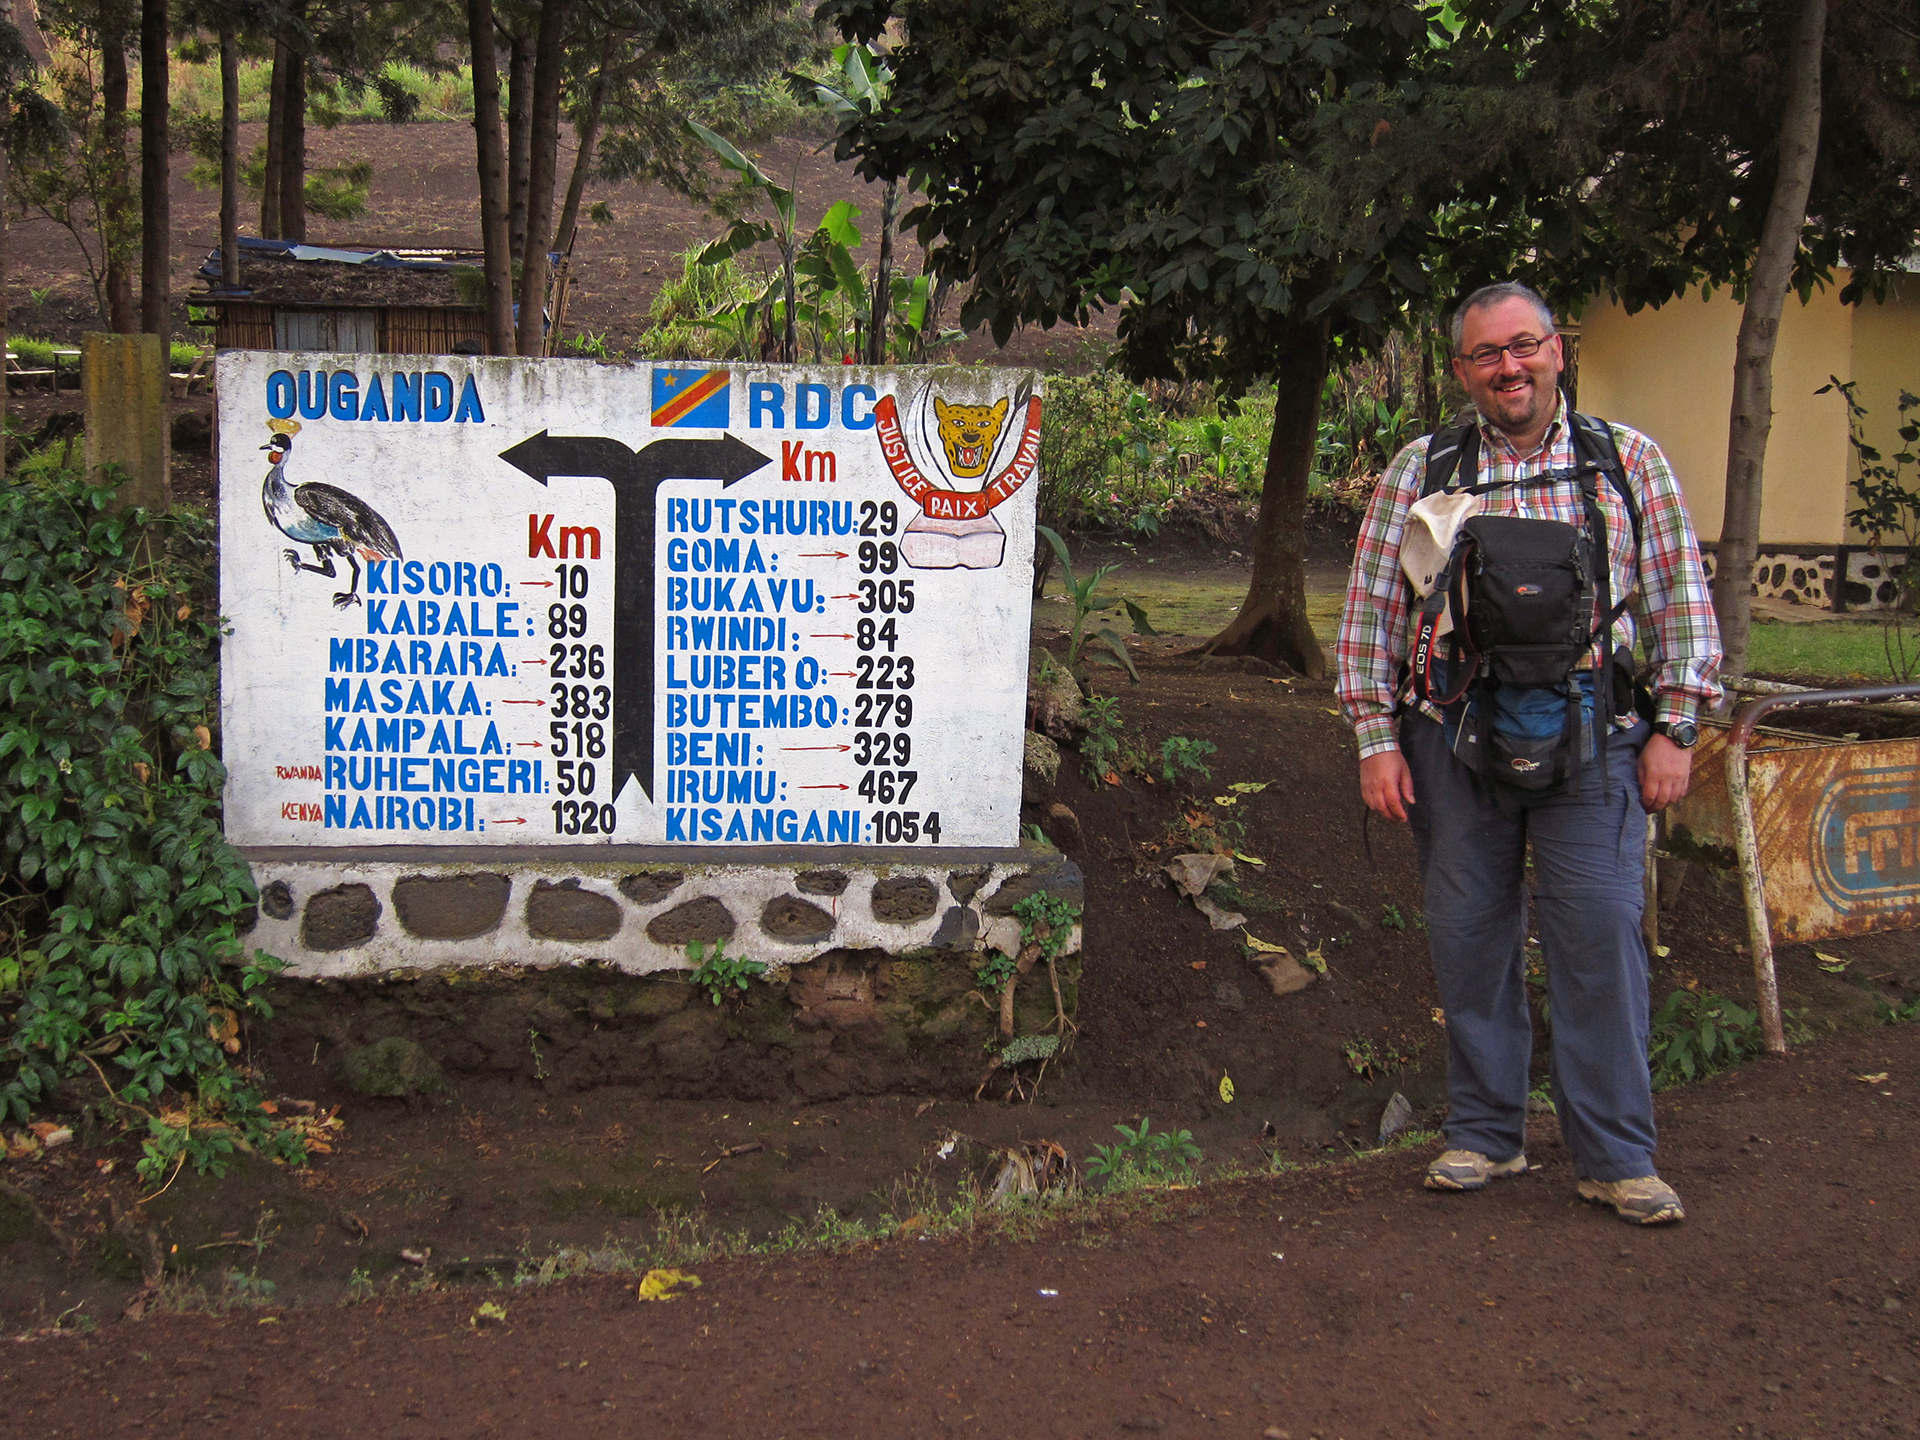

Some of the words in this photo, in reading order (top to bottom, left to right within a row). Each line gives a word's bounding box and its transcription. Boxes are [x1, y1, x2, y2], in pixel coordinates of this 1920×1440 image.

[267, 372, 485, 423] OUGANDA
[750, 383, 876, 430] RDC
[782, 441, 836, 482] Km
[877, 416, 928, 498] JUSTICE
[992, 427, 1042, 498] TRAVAIL
[668, 498, 858, 535] RUTSHURU:
[860, 501, 897, 537] 29
[930, 495, 978, 518] PAIX
[530, 514, 600, 559] Km
[668, 538, 778, 573] GOMA:
[856, 541, 899, 576] 99
[368, 561, 510, 597] KISORO:
[557, 564, 588, 598] 10
[668, 577, 825, 613] BUKAVU:
[857, 579, 916, 614] 305
[368, 600, 534, 637] KABALE:
[549, 603, 586, 639] 89
[668, 616, 799, 651] RWINDI:
[857, 617, 899, 654] 84
[1421, 625, 1432, 640] 7D
[330, 636, 518, 676] MBARARA:
[550, 643, 604, 679] 236
[855, 655, 916, 690] 223
[1416, 643, 1427, 674] EOS
[325, 678, 491, 715] MASAKA:
[551, 683, 609, 720] 383
[667, 694, 848, 728] BUTEMBO:
[855, 694, 912, 727] 279
[326, 717, 510, 754] KAMPALA:
[551, 722, 605, 758] 518
[668, 733, 763, 766] BENI:
[854, 732, 910, 766] 329
[277, 766, 322, 779] RWANDA
[325, 756, 549, 793] RUHENGERI:
[557, 761, 595, 796] 50
[668, 770, 786, 804] IRUMU:
[859, 770, 917, 804] 467
[282, 803, 322, 821] KENYA
[325, 795, 484, 831] NAIROBI:
[551, 799, 617, 836] 1320
[667, 808, 871, 842] KISANGANI:
[872, 811, 941, 843] 1054
